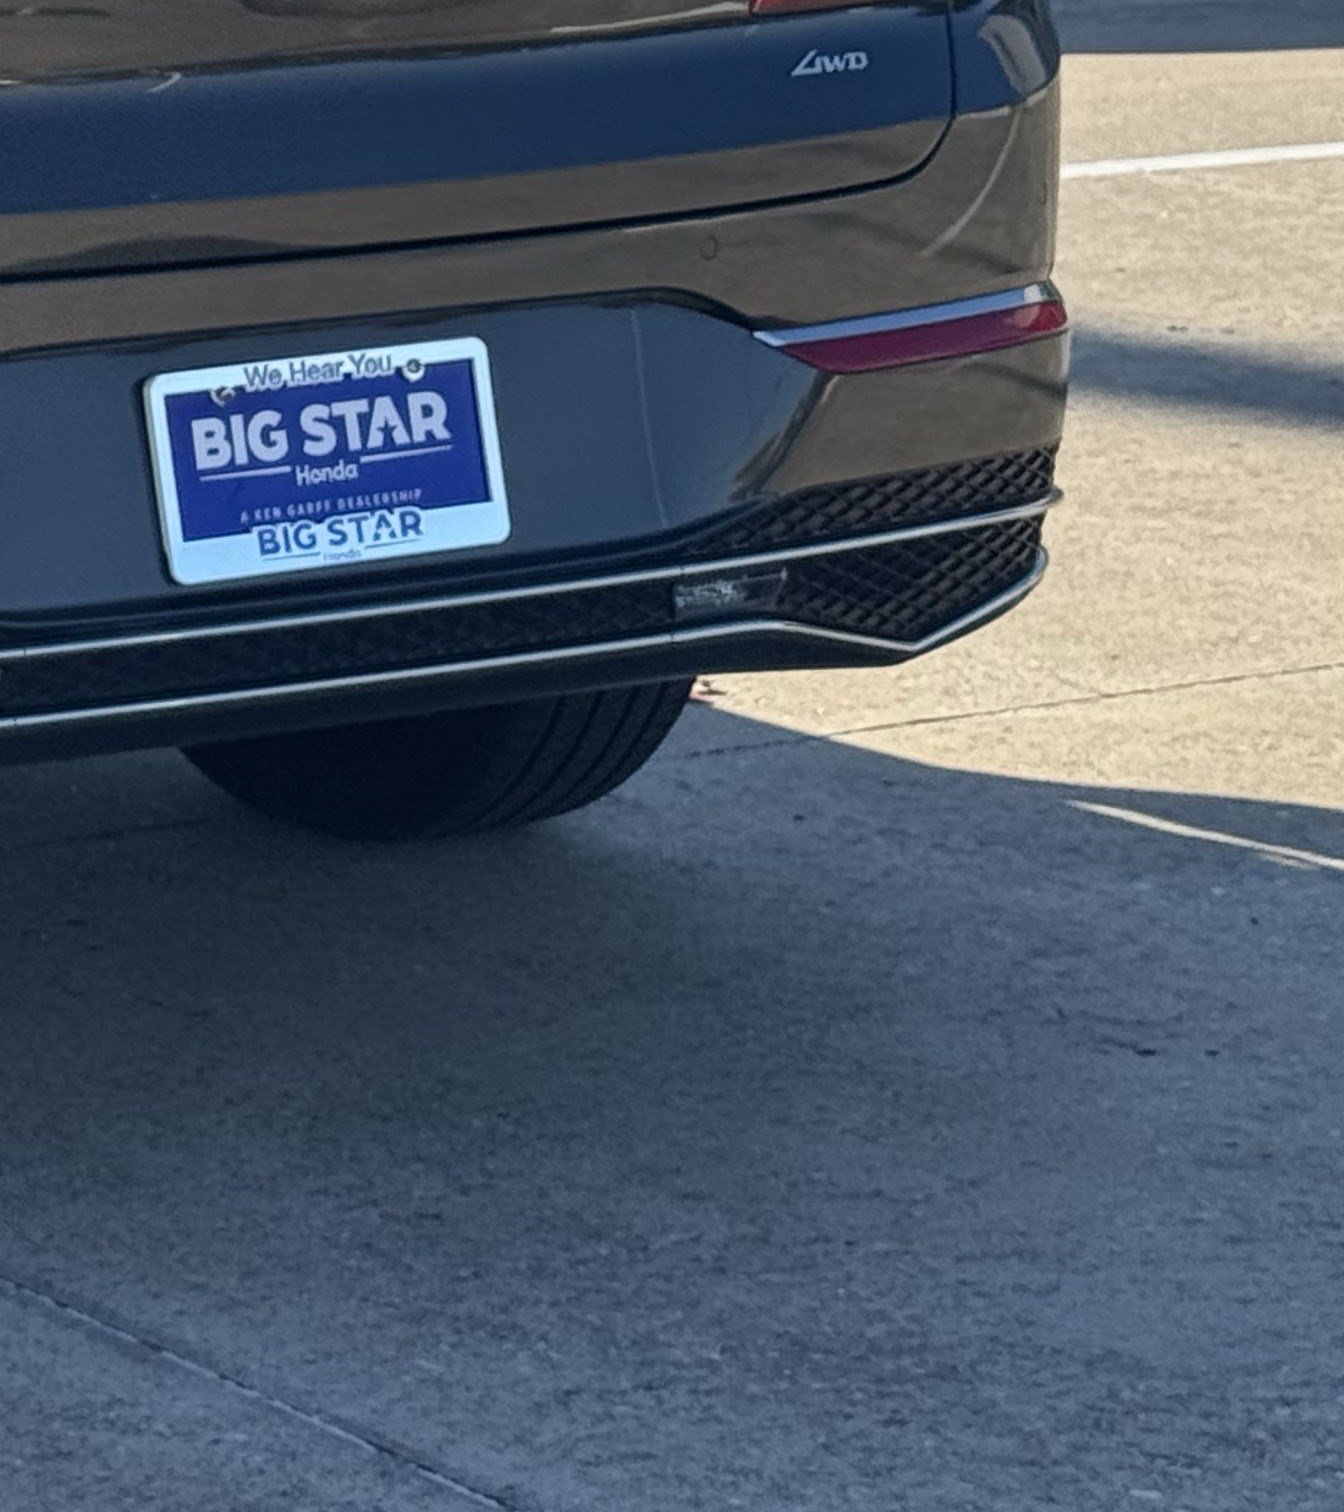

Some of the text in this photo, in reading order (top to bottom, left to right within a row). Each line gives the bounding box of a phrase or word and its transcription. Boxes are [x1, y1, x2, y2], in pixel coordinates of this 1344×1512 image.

[243, 353, 392, 387] We Hear You
[191, 391, 452, 471] BIG STAR
[295, 459, 359, 487] Honda
[336, 488, 422, 511] DEALERSHIP
[257, 509, 423, 556] BIG STAR
